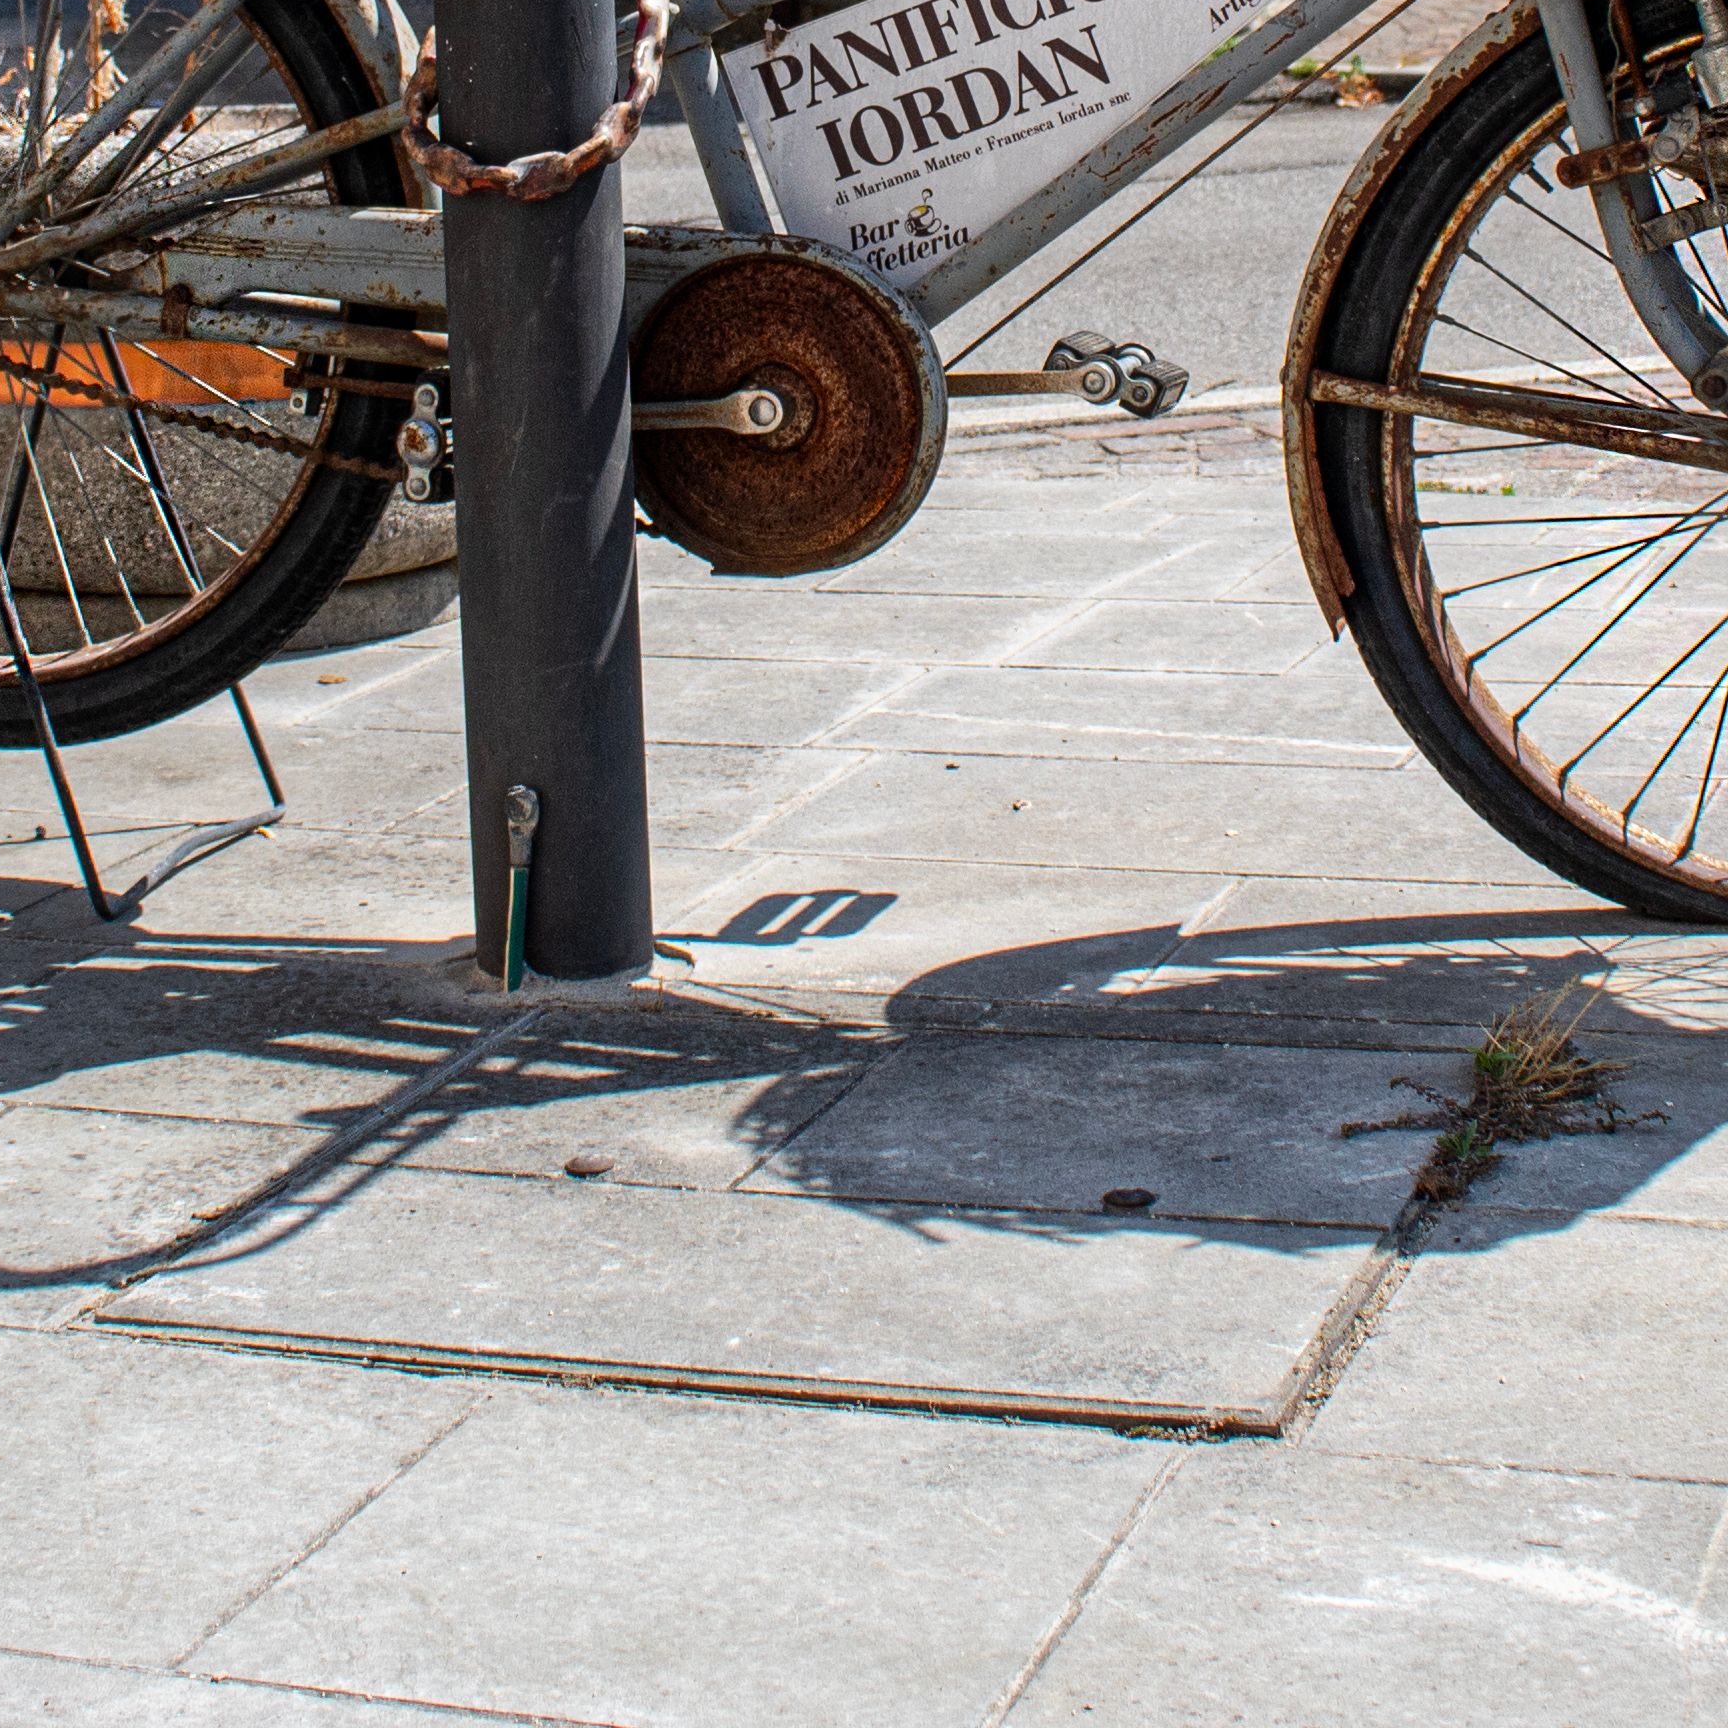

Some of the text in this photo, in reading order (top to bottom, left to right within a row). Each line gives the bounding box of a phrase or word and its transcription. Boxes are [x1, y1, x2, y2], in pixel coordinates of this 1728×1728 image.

[815, 24, 1111, 181] IORDAN
[835, 89, 1132, 207] di Marianna Matteo e Francesca Iordan snc
[848, 219, 900, 251] Bar
